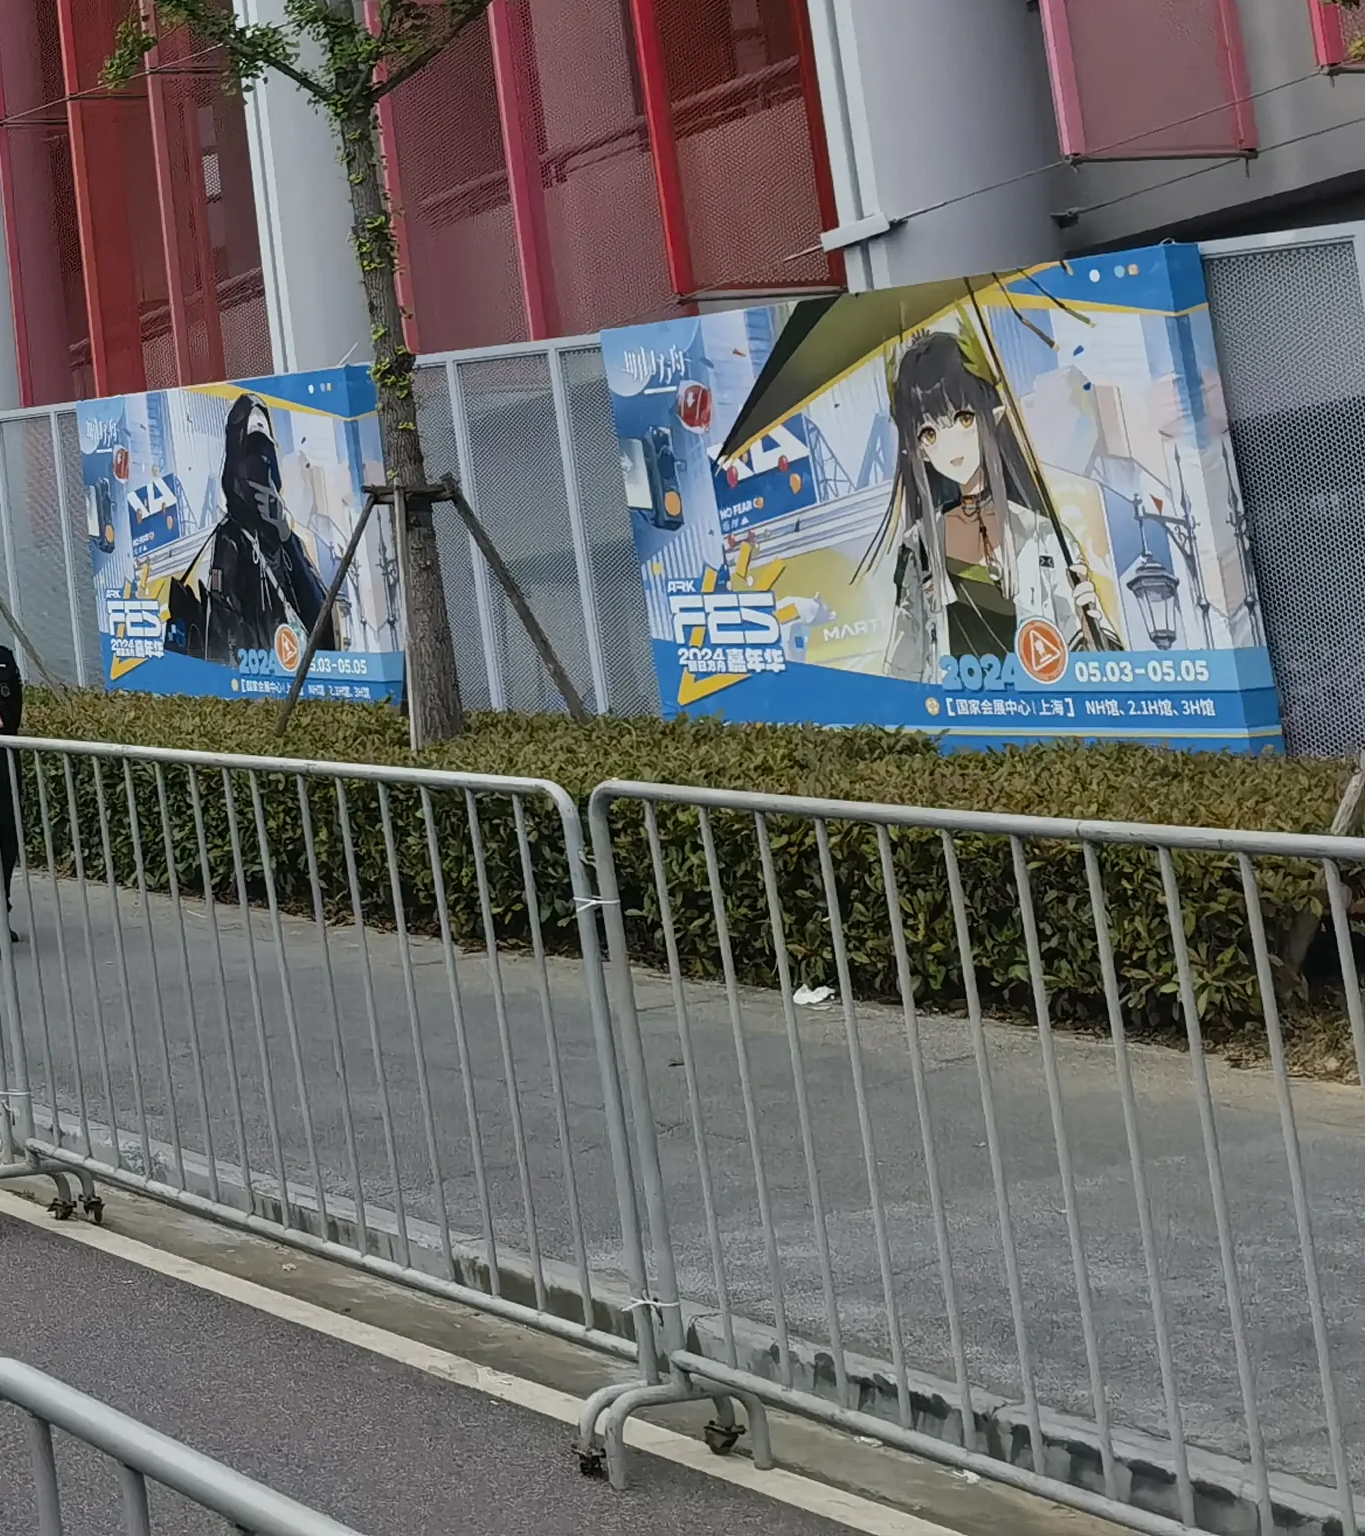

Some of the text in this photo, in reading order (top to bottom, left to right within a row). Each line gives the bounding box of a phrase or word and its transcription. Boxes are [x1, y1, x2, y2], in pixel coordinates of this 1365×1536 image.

[668, 580, 696, 593] ARK
[669, 592, 780, 645] FES
[307, 657, 368, 674] 5.03-05.05
[940, 652, 1018, 691] 2024
[1075, 660, 1210, 683] 05.03-05.05
